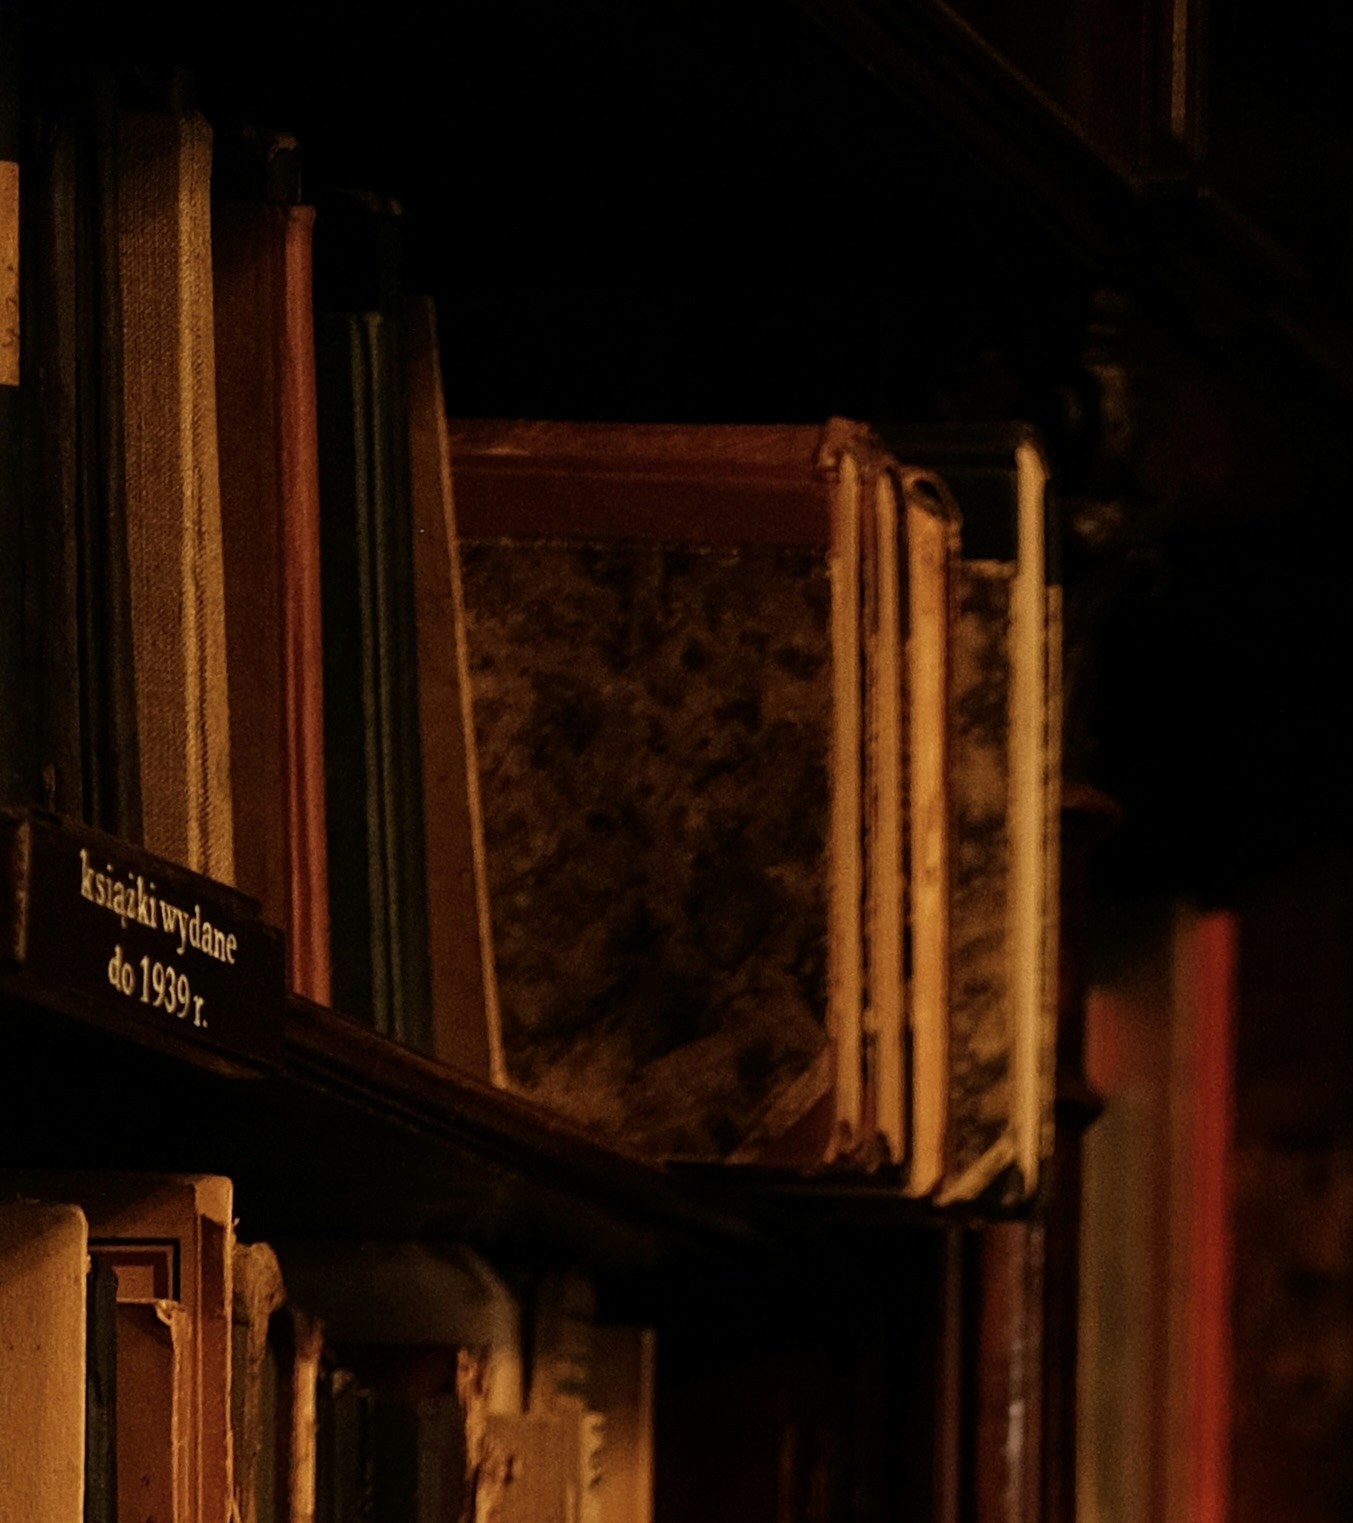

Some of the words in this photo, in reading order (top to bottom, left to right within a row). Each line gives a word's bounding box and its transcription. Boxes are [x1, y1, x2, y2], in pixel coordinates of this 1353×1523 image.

[79, 847, 158, 930] książki
[159, 903, 239, 966] wydane
[107, 942, 137, 997] do
[139, 954, 191, 1020] 1939
[192, 993, 209, 1029] r.
